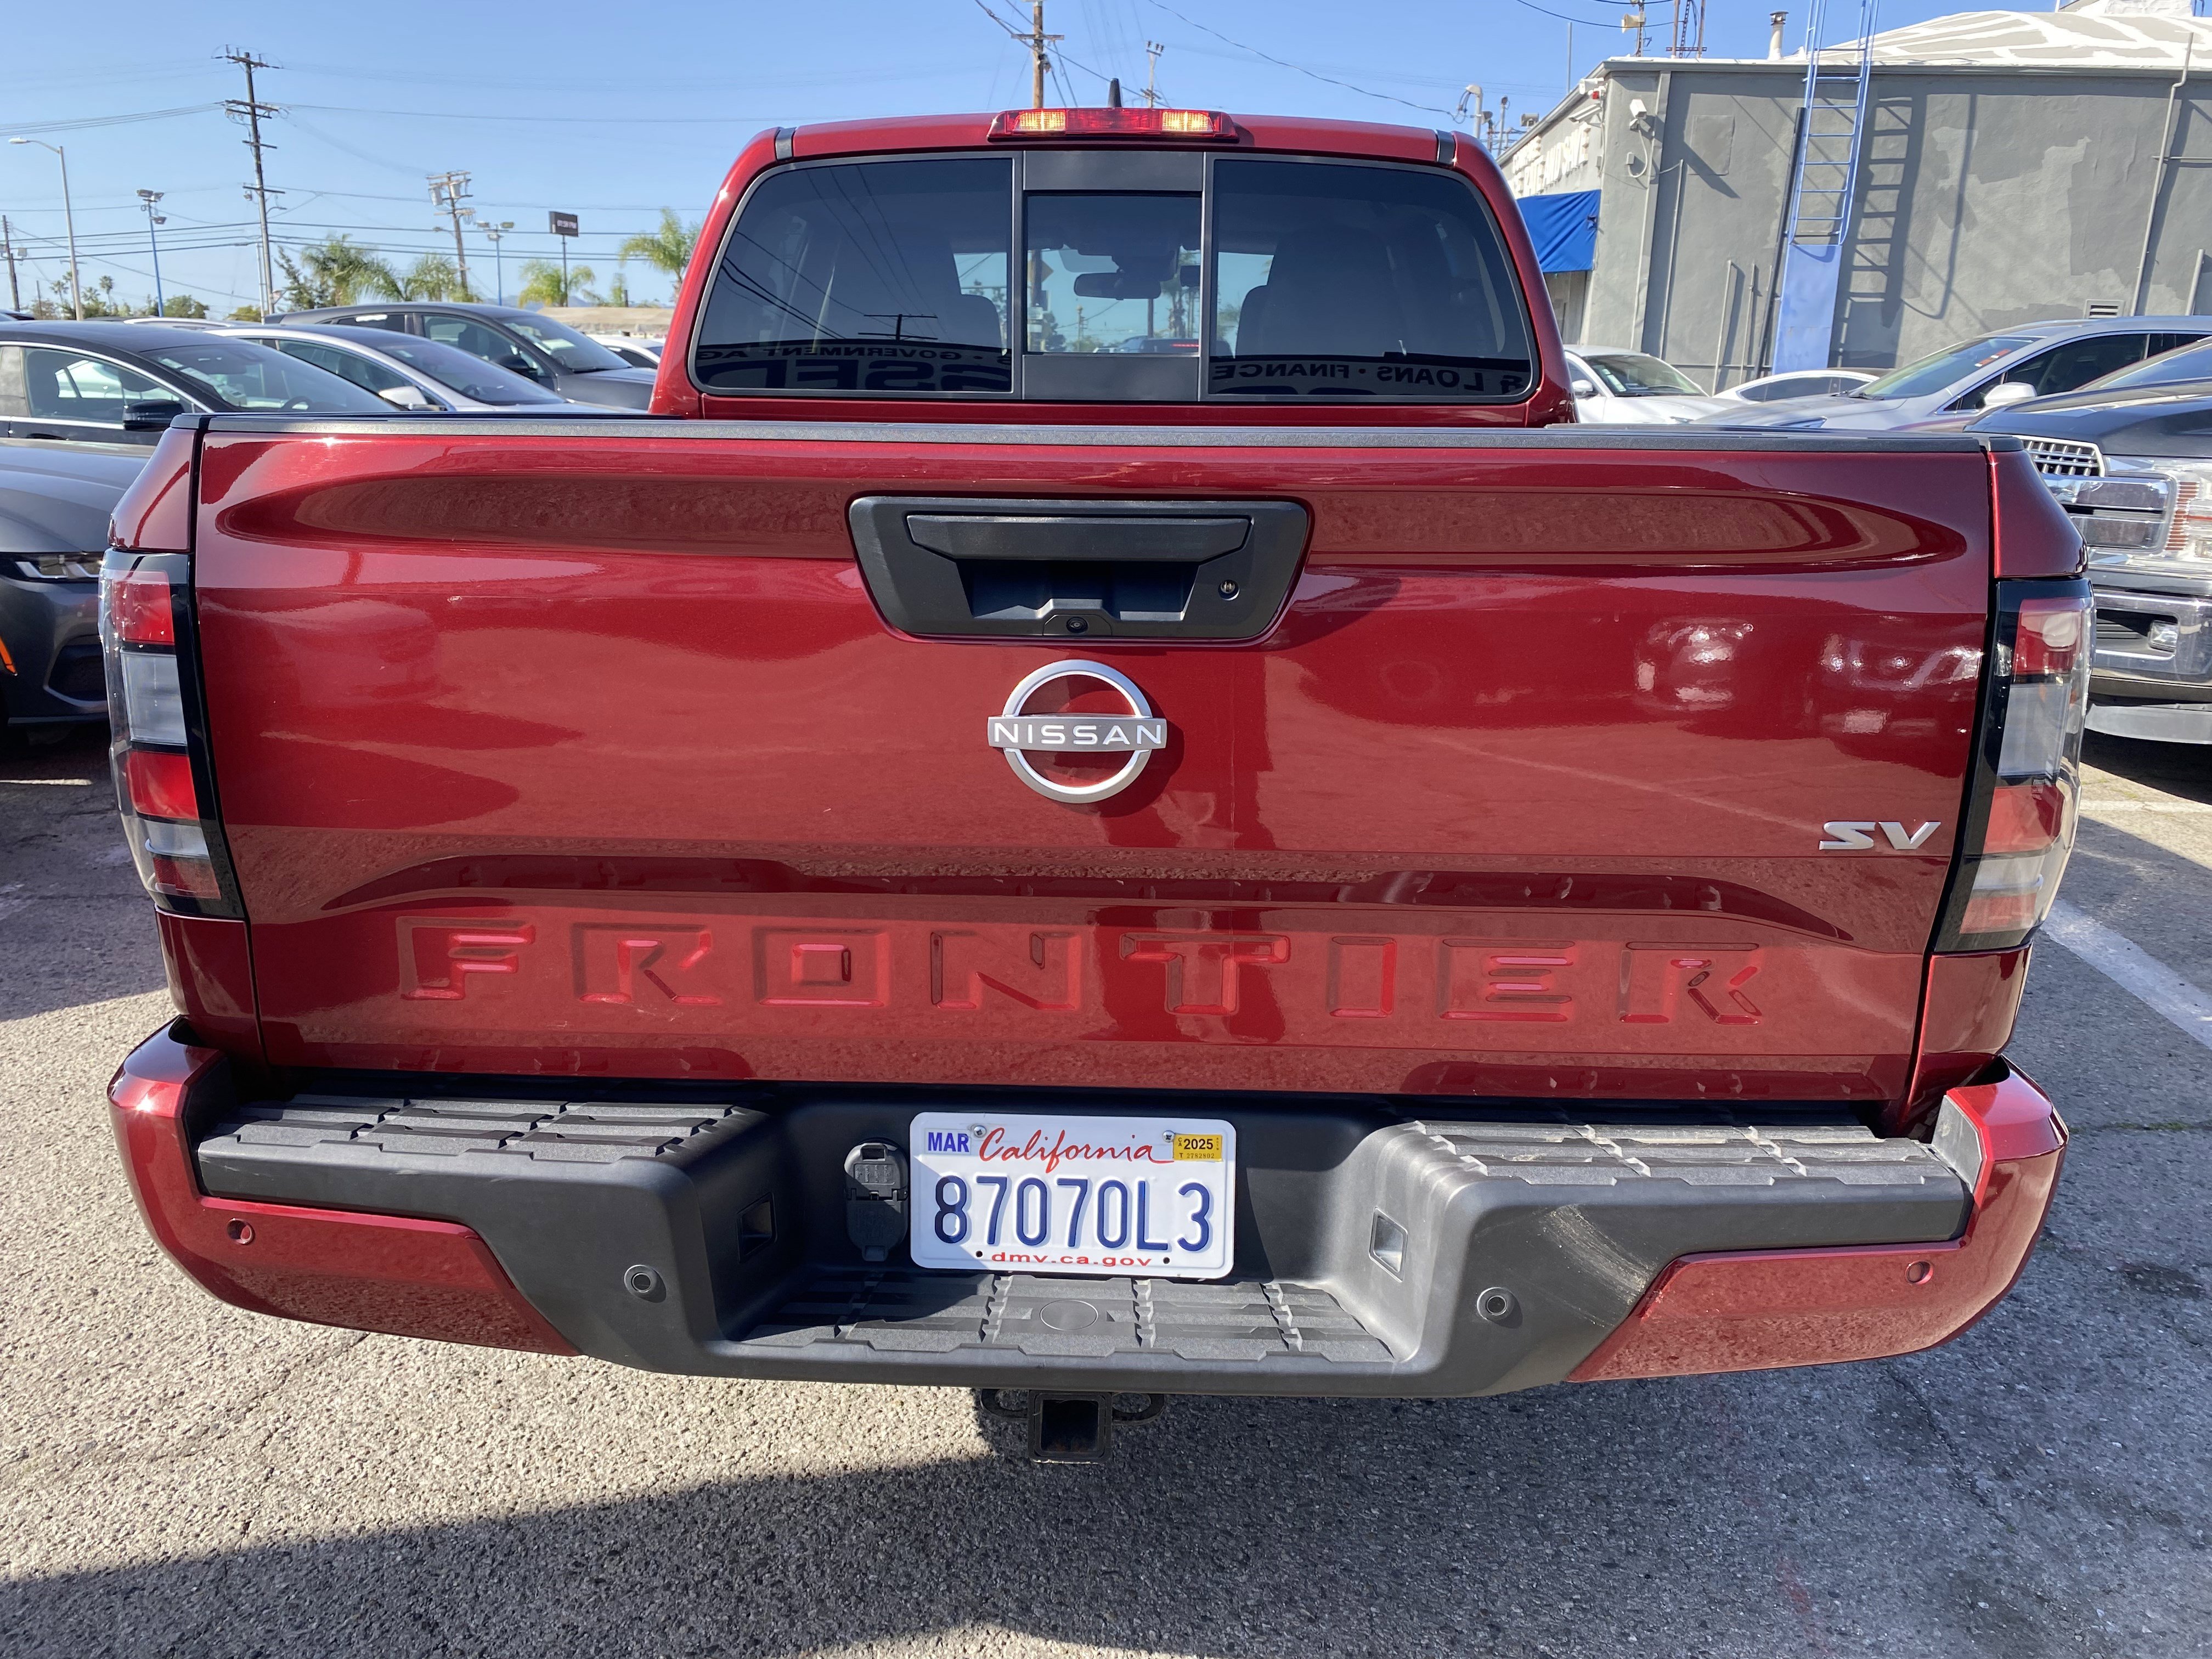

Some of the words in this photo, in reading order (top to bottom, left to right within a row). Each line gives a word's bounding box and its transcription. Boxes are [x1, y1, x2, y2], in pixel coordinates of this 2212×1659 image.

[994, 723, 1161, 746] NISSAN
[1819, 821, 1942, 850] SV
[396, 916, 1762, 1024] FRONTIER
[928, 1132, 969, 1153] MAR
[979, 1127, 1174, 1173] California
[1183, 1138, 1214, 1150] 2025
[934, 1175, 1210, 1251] 87070L3
[991, 1252, 1153, 1267] dmv.ca.gov
